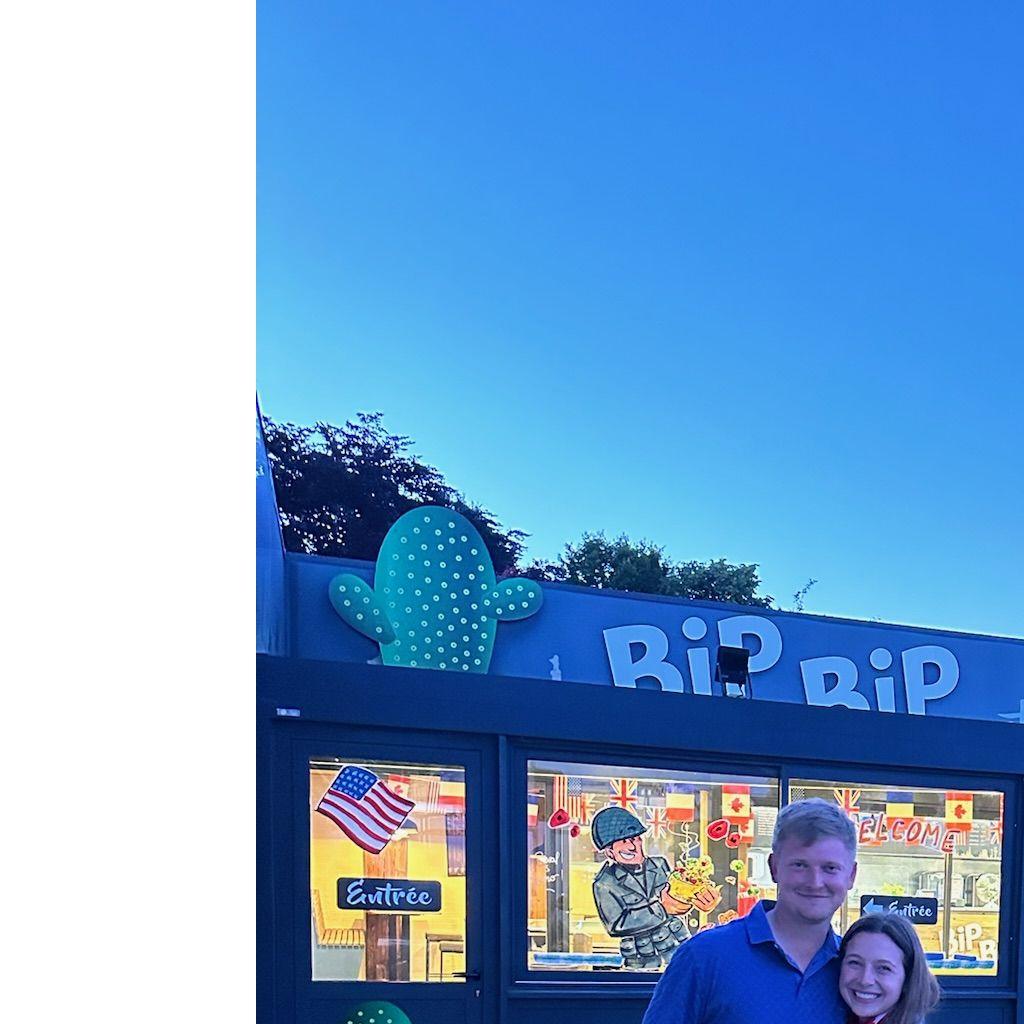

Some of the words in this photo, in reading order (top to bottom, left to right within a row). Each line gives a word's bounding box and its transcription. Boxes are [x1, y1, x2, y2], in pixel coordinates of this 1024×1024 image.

[799, 644, 961, 716] BiP
[850, 812, 961, 852] ELCOME
[346, 878, 433, 907] Entrée
